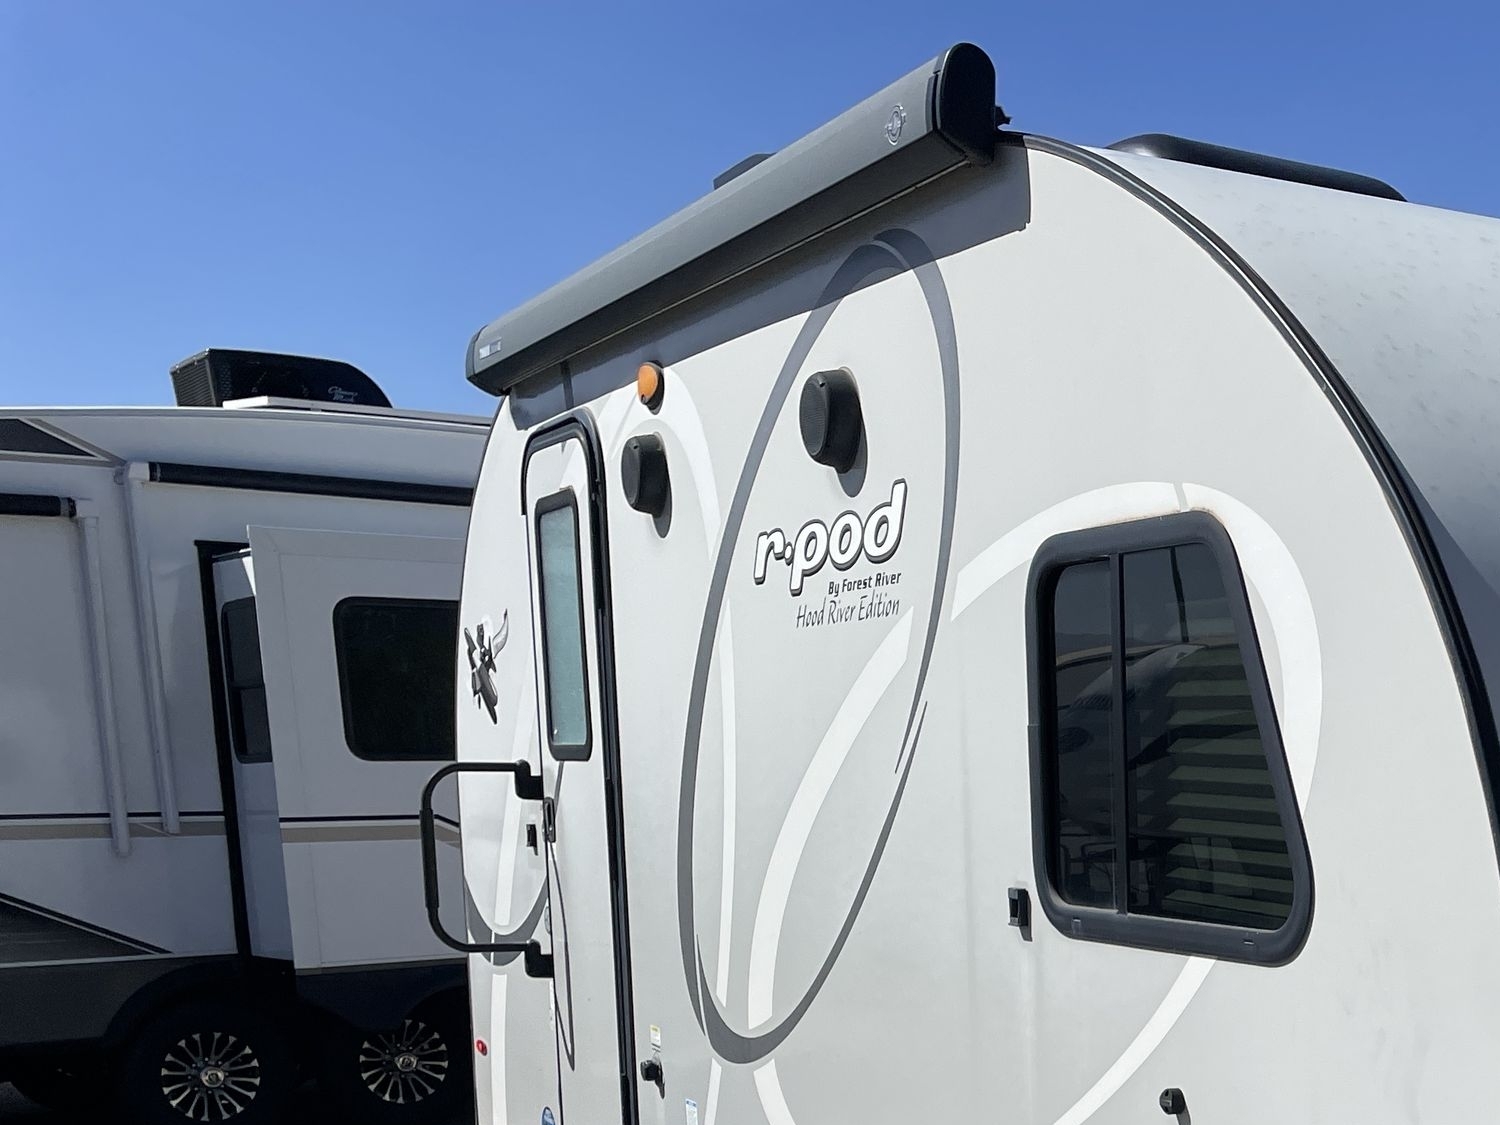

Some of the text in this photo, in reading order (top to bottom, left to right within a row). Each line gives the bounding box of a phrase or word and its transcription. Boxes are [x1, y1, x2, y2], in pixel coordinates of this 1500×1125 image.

[828, 571, 902, 597] By Forest River
[796, 589, 900, 628] Hood River Edition
